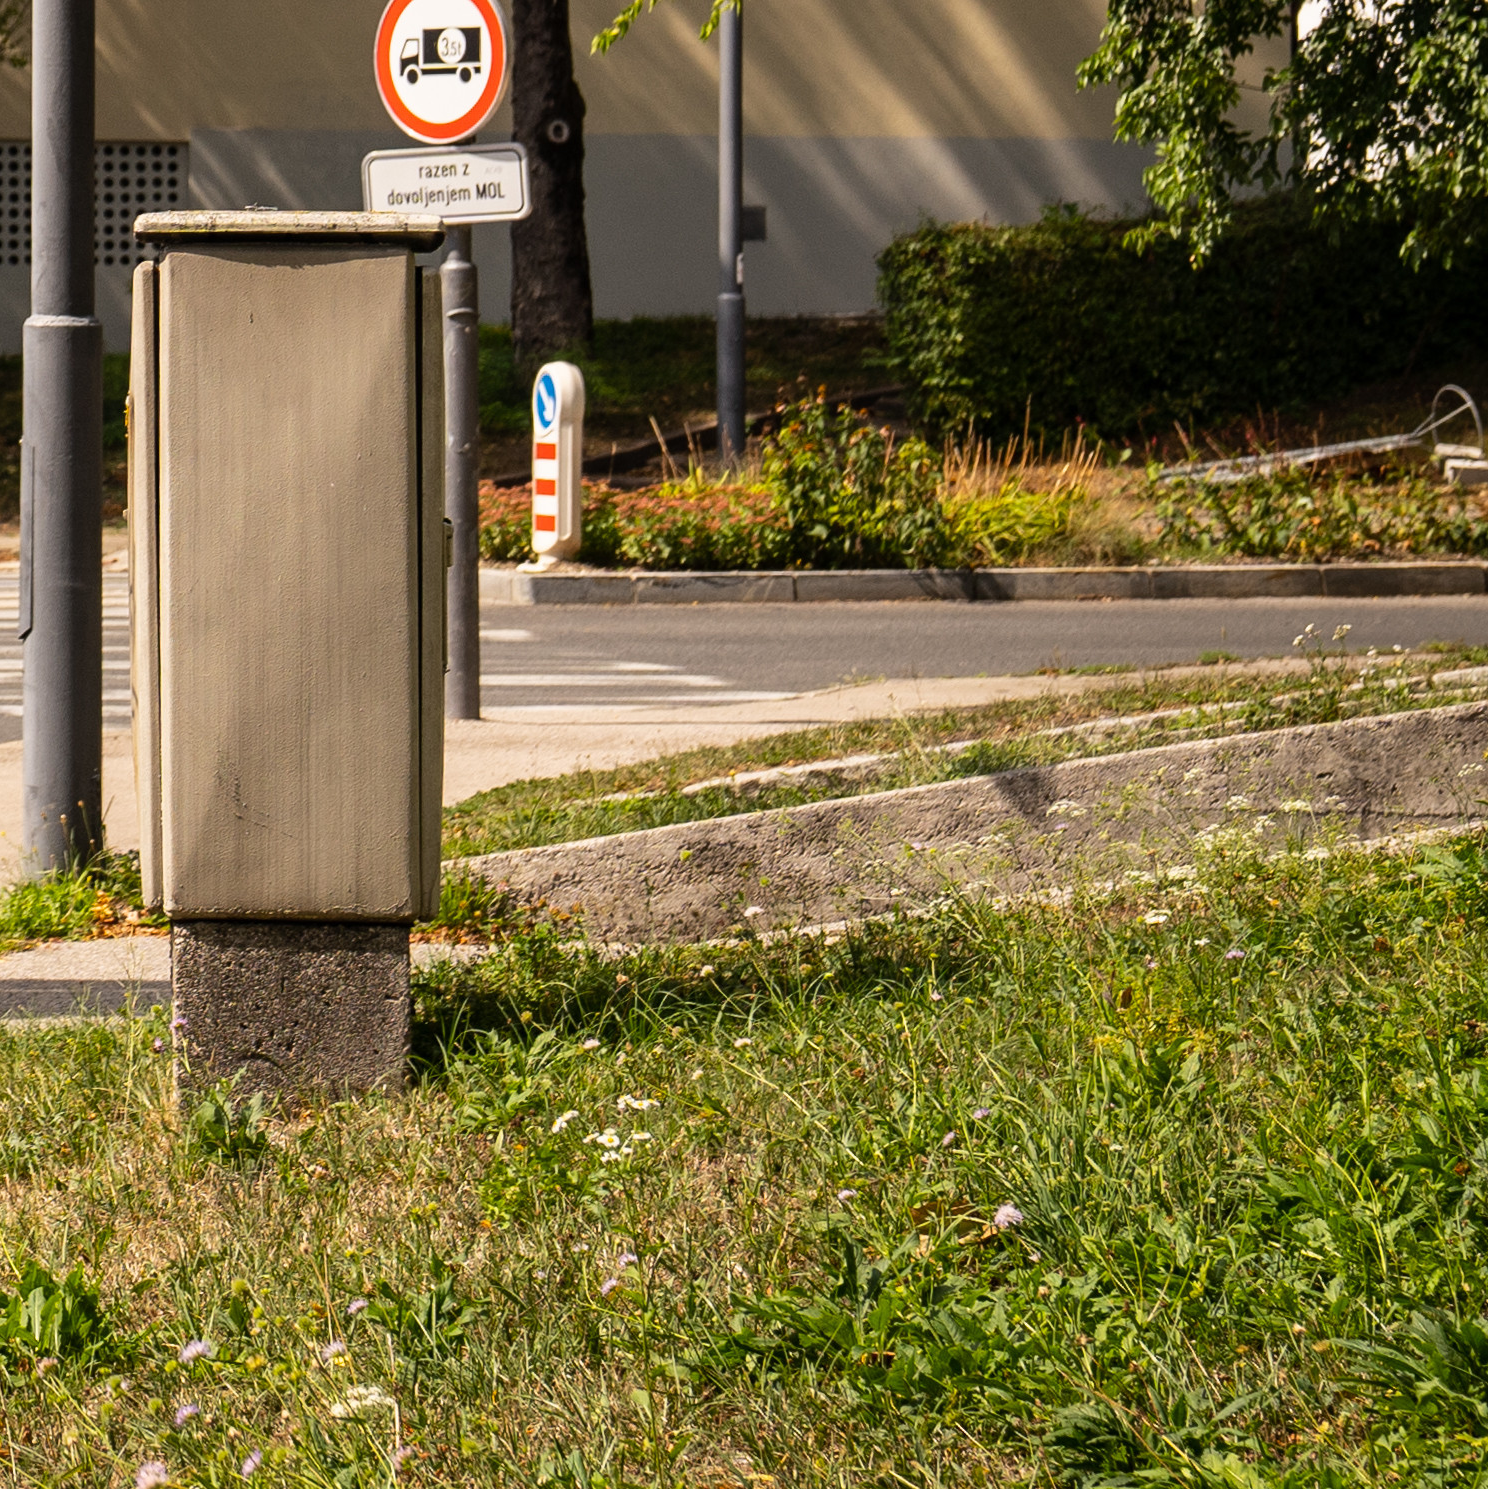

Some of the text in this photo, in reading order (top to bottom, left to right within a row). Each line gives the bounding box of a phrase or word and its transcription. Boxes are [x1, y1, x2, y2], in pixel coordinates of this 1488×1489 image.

[418, 164, 457, 179] razen
[462, 163, 470, 176] z
[387, 182, 505, 208] dovoljenjem MOL
